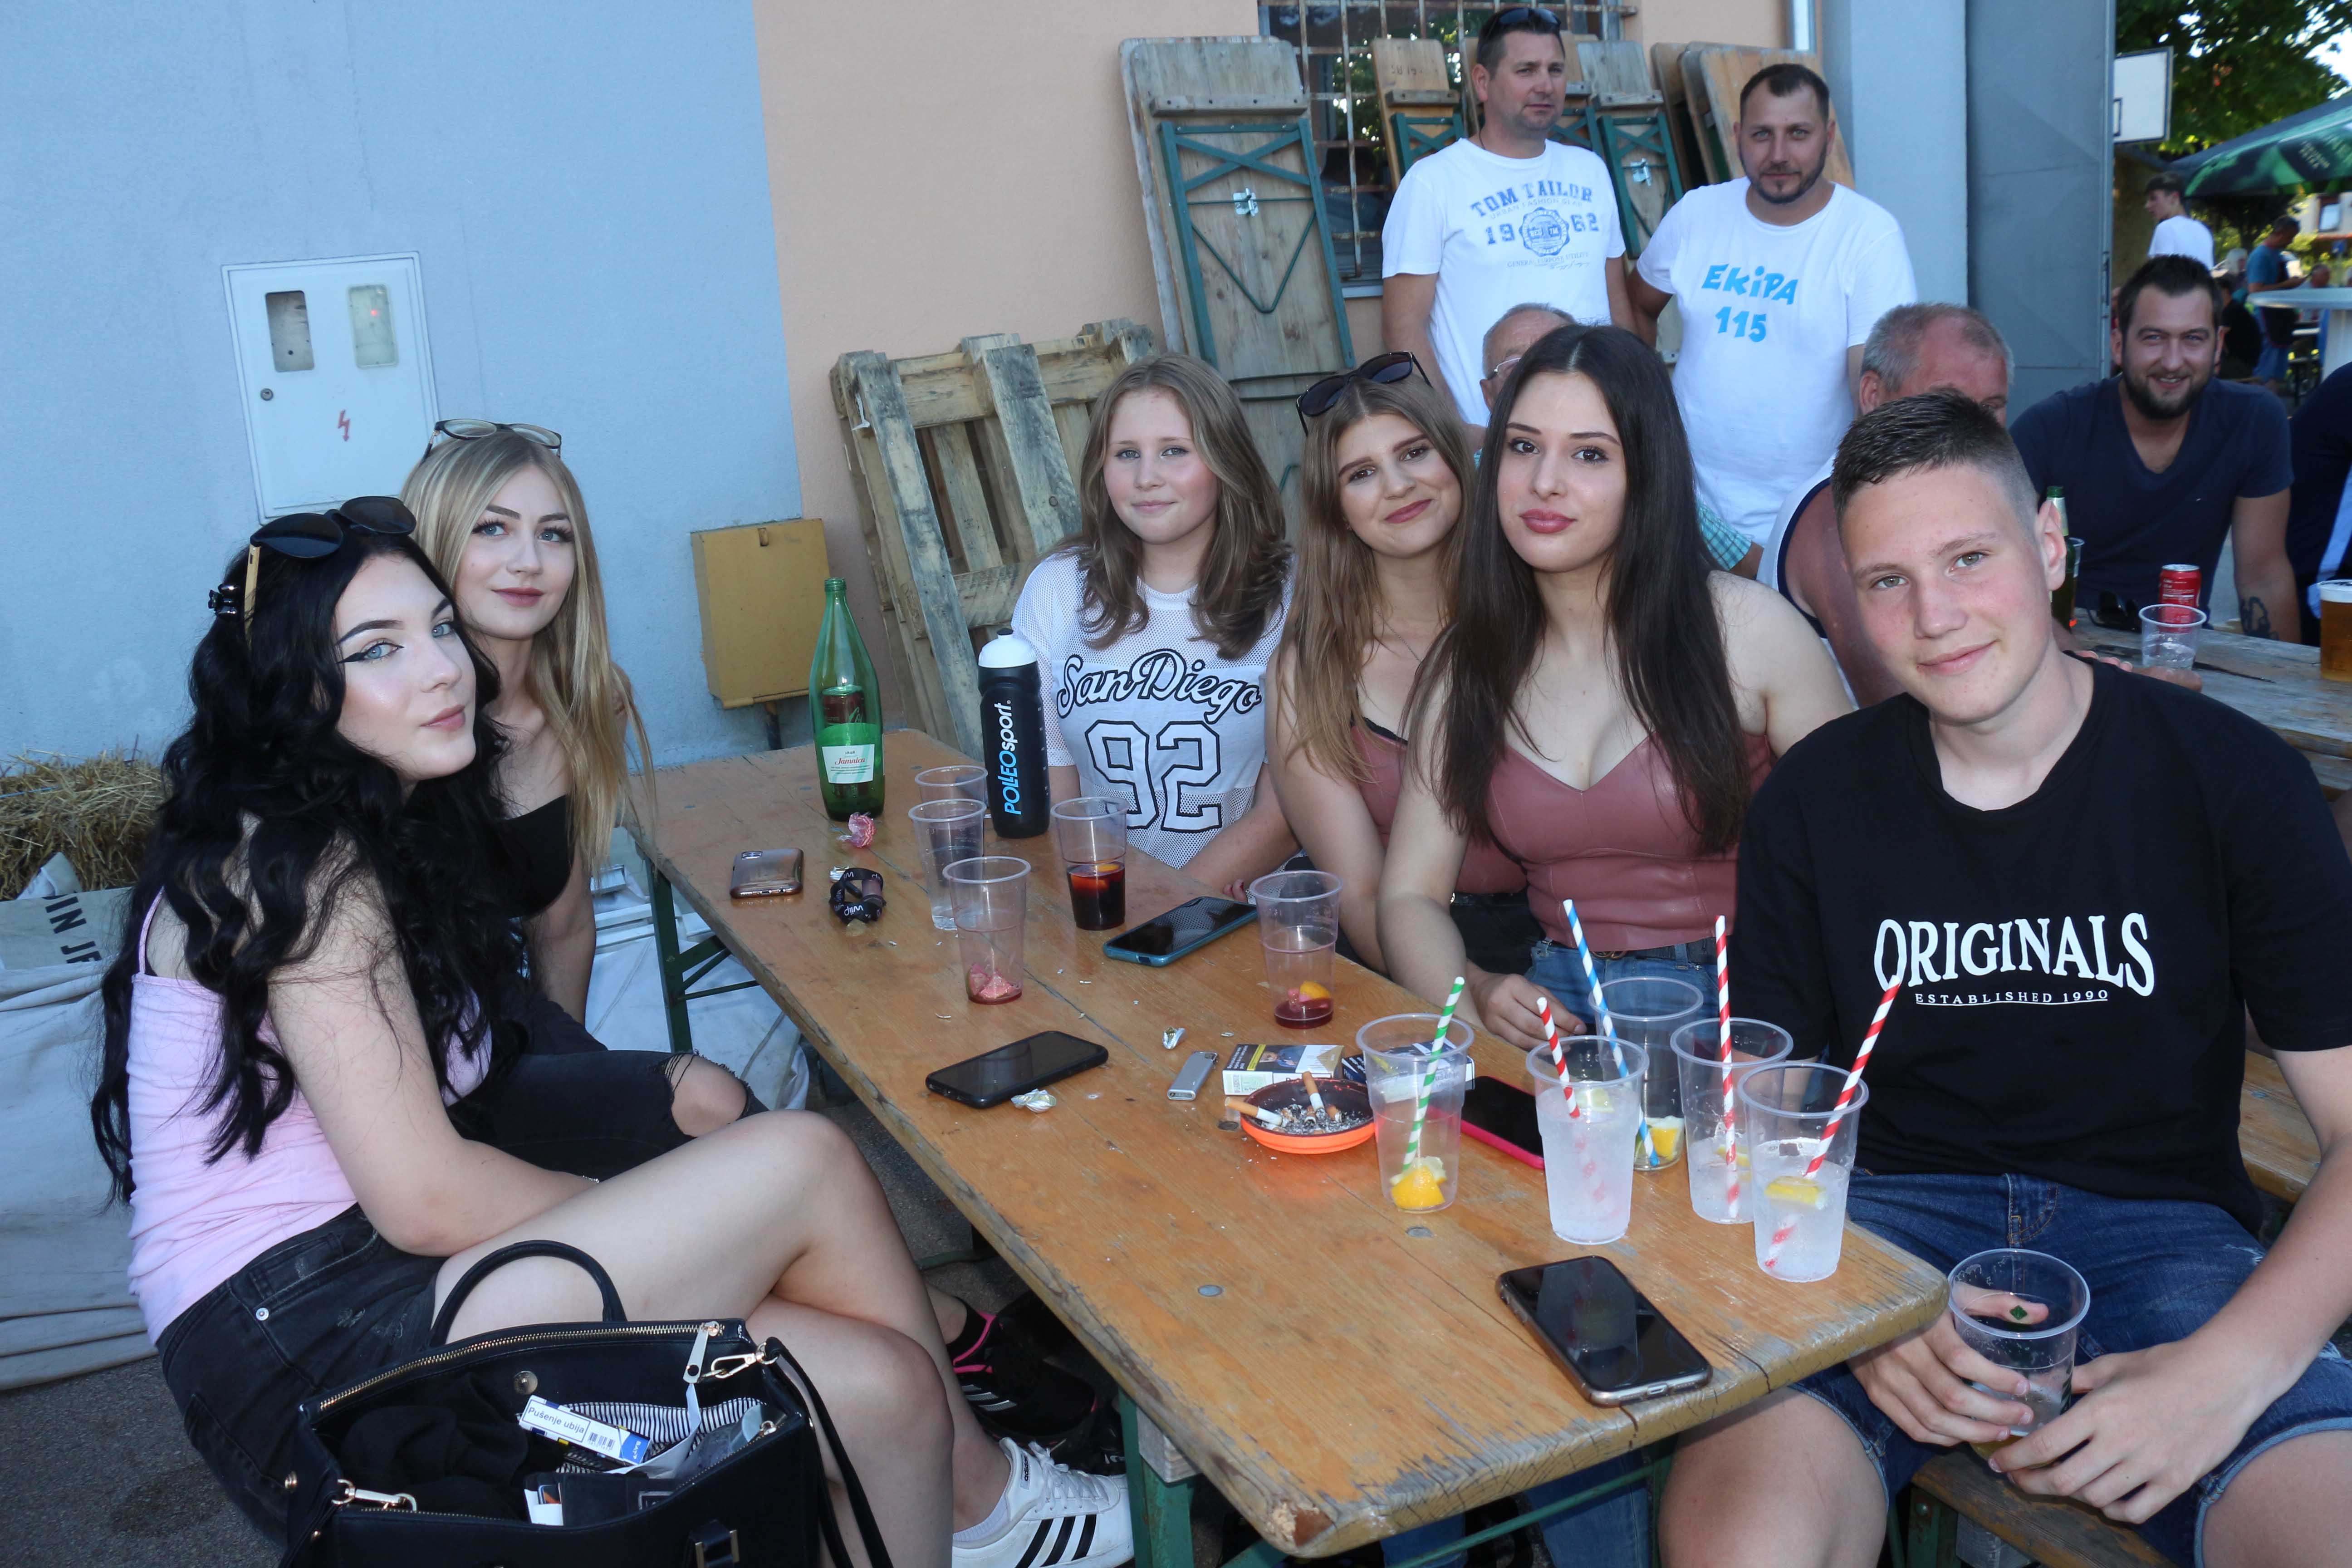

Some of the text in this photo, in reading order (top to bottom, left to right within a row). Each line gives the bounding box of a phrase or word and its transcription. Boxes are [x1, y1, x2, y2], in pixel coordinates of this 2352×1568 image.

[1470, 180, 1592, 217] TOM TAILOR
[1490, 205, 1520, 219] URBAN
[1522, 197, 1558, 208] FASHION
[1485, 223, 1515, 245] 19
[1570, 212, 1600, 233] 62
[1715, 306, 1767, 343] 115
[834, 757, 865, 765] Jamnica
[1085, 720, 1222, 834] 92
[42, 894, 87, 934] IN
[1874, 912, 2156, 996] ORIGINALS
[1915, 989, 2108, 1004] ESTABLISHED 1990
[527, 1406, 585, 1434] Pušenje ubija
